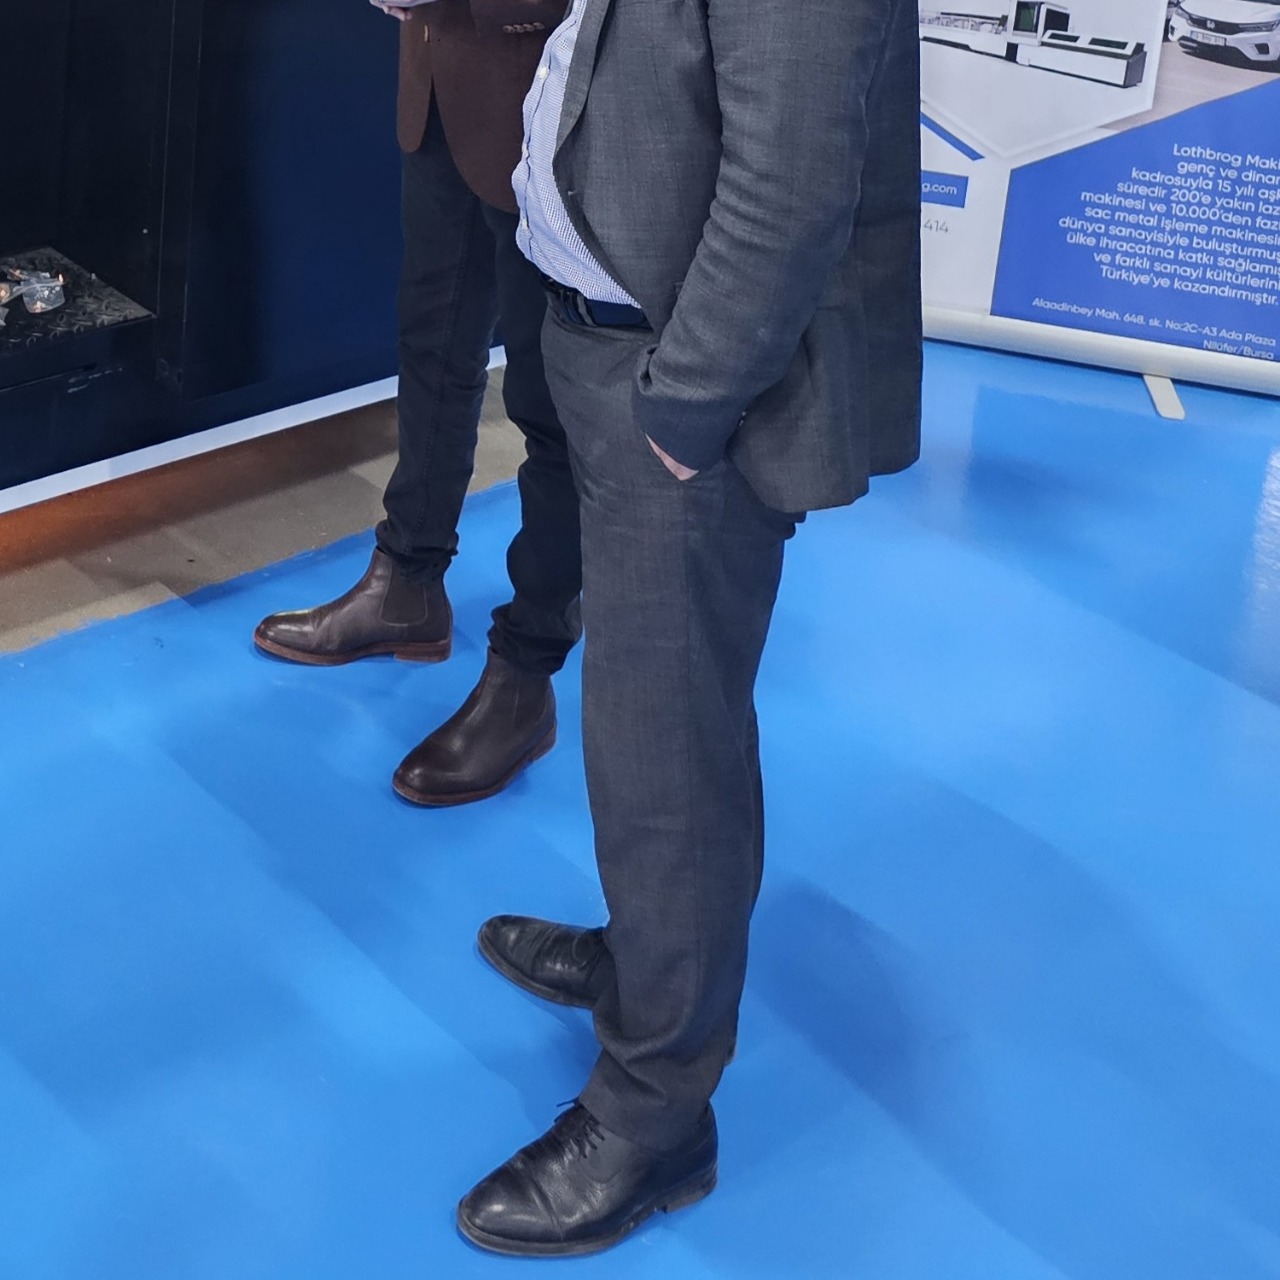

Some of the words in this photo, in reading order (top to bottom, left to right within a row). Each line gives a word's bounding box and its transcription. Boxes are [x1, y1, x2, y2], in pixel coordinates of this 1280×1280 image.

[1173, 143, 1242, 167] Lothbrog
[1177, 161, 1216, 177] genç
[1220, 165, 1238, 179] ve
[1117, 182, 1167, 198] süredir
[1170, 188, 1211, 204] 200'e
[1214, 196, 1255, 212] yakın
[1131, 167, 1212, 190] kadrosuyla
[1217, 179, 1231, 192] 15
[1235, 184, 1255, 197] yılı
[1081, 191, 1145, 210] makinesi
[1149, 201, 1166, 213] ve
[1170, 202, 1251, 227] 10.000'den
[1084, 206, 1111, 220] sac
[1114, 210, 1158, 227] metal
[1161, 217, 1208, 234] işleme
[923, 218, 948, 233] 414
[1058, 216, 1106, 234] dünya
[1108, 224, 1190, 247] sanayisiyle
[1066, 231, 1096, 247] ülke
[1099, 236, 1175, 259] ihracatına
[1178, 249, 1214, 265] katkı
[1093, 251, 1112, 264] ve
[1115, 253, 1150, 269] farklı
[1153, 260, 1203, 279] sanayi
[1100, 265, 1170, 287] Türkiye'ye
[1174, 277, 1279, 306] kazandırmıştır.
[1032, 297, 1093, 317] Alaadinbey
[1095, 307, 1121, 320] Mah.
[1149, 317, 1162, 328] sk.
[1165, 319, 1218, 337] No:2C-A3
[1219, 328, 1242, 341] Ada
[1245, 332, 1276, 347] Plaza
[1203, 338, 1274, 360] Nilüfer/Bursa
